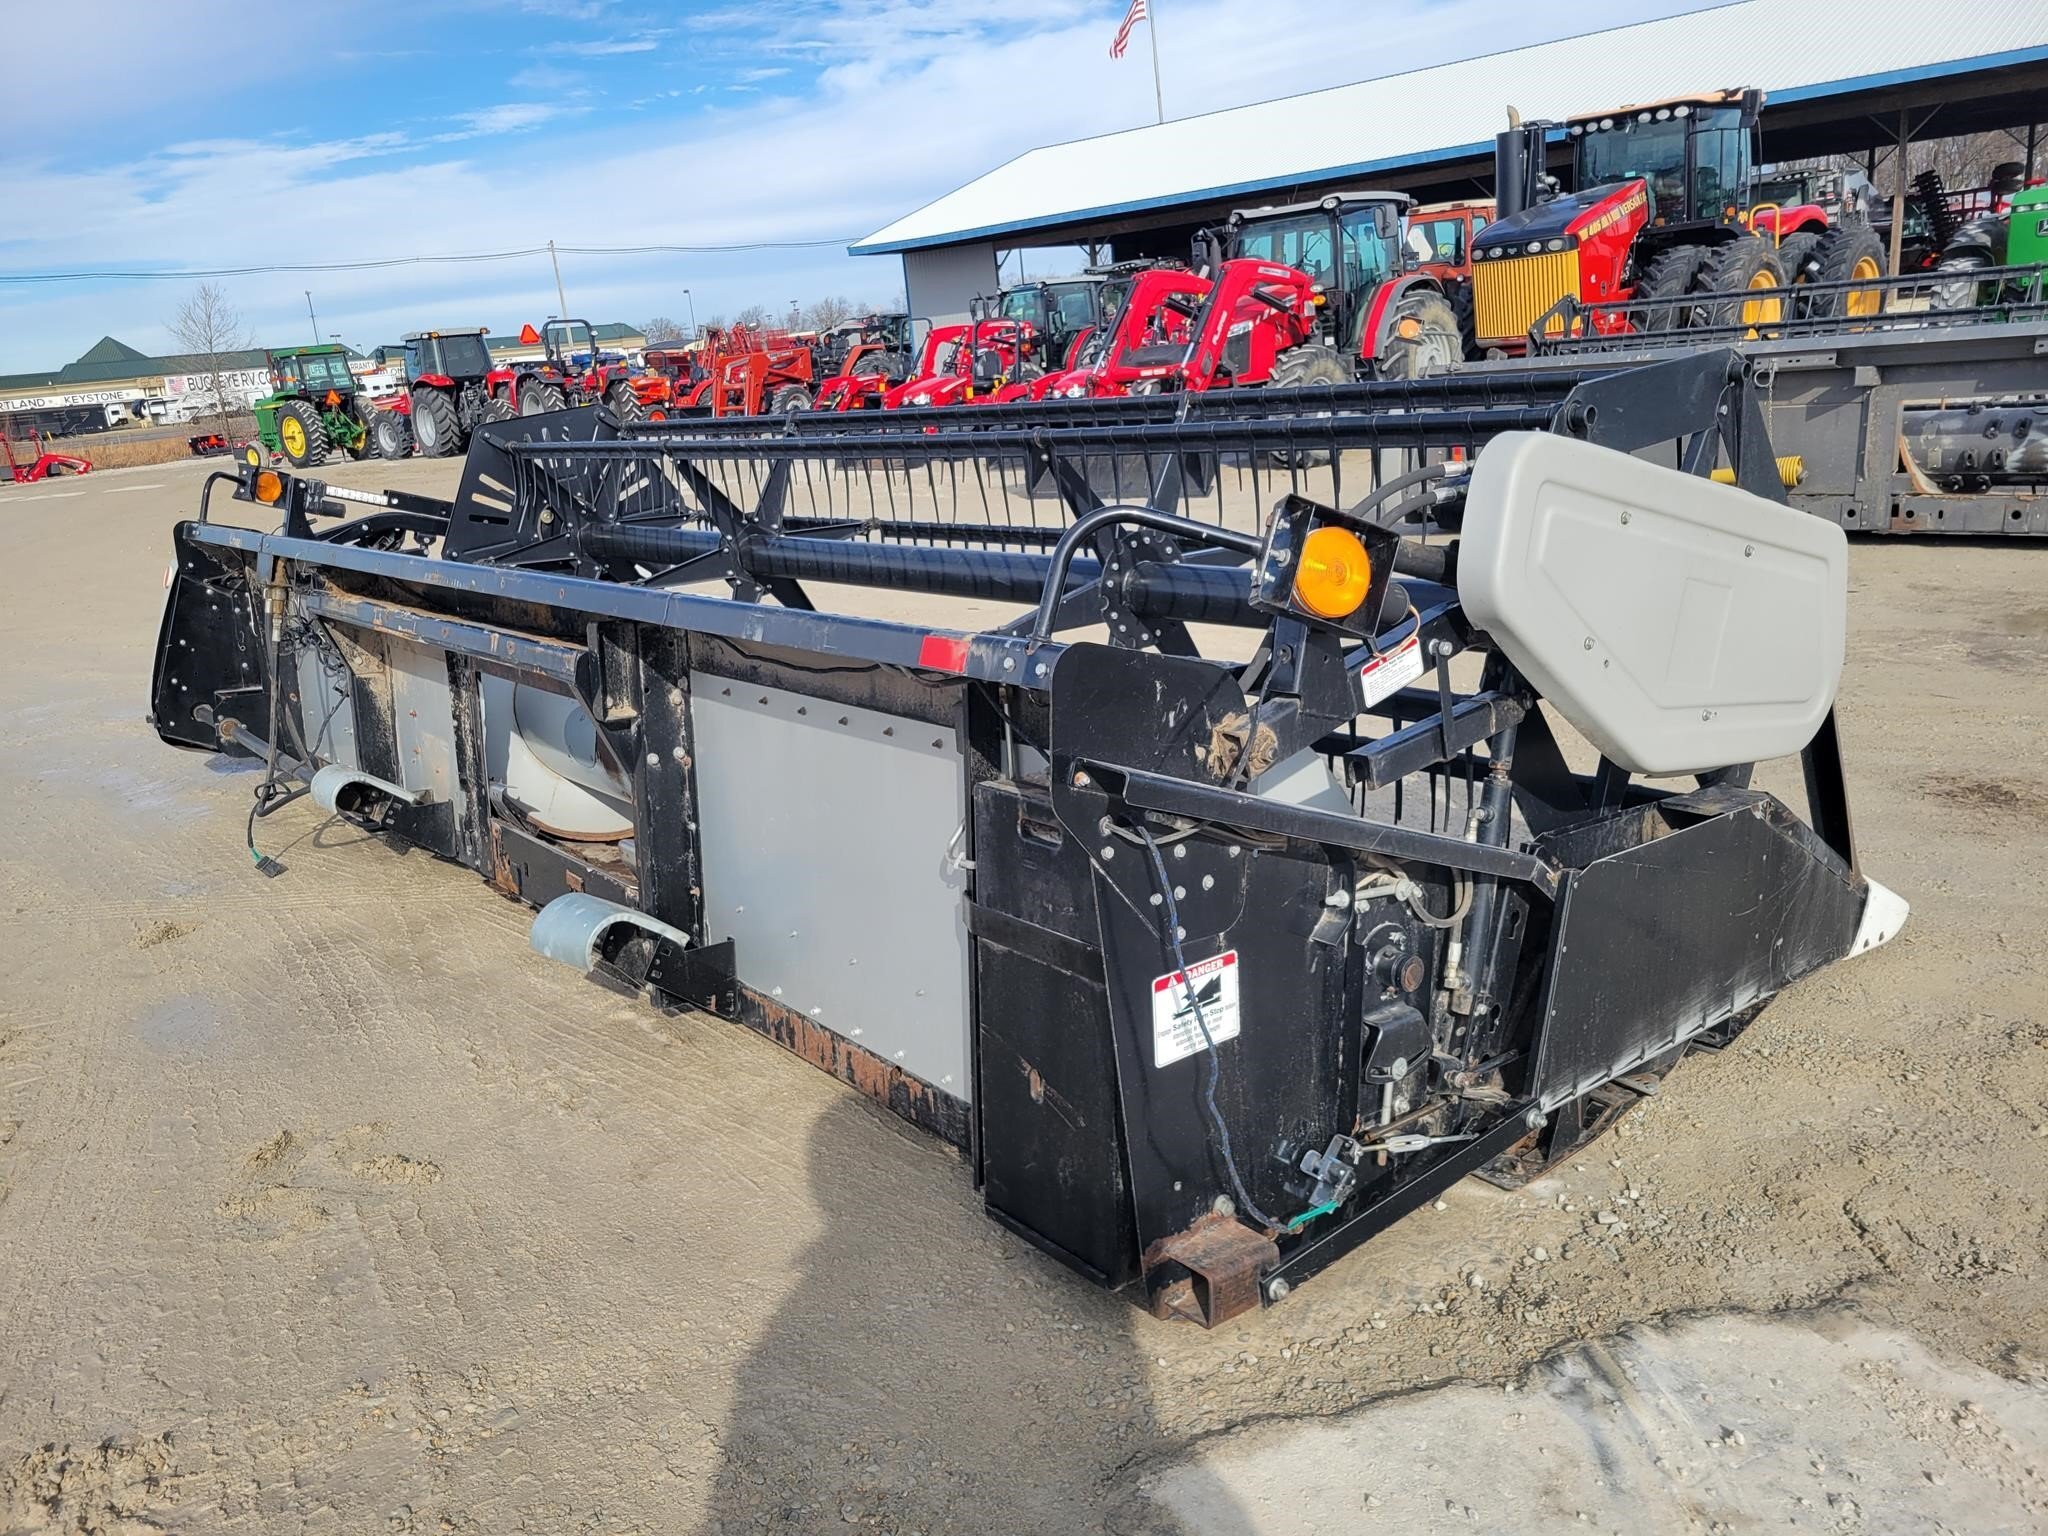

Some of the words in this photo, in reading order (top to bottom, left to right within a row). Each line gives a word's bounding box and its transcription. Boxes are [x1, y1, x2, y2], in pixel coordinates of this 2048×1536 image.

[64, 391, 123, 404] KEYSTONE
[1186, 959, 1224, 980] DANGER
[1172, 1019, 1193, 1032] Safety
[1209, 1006, 1224, 1016] Stop
